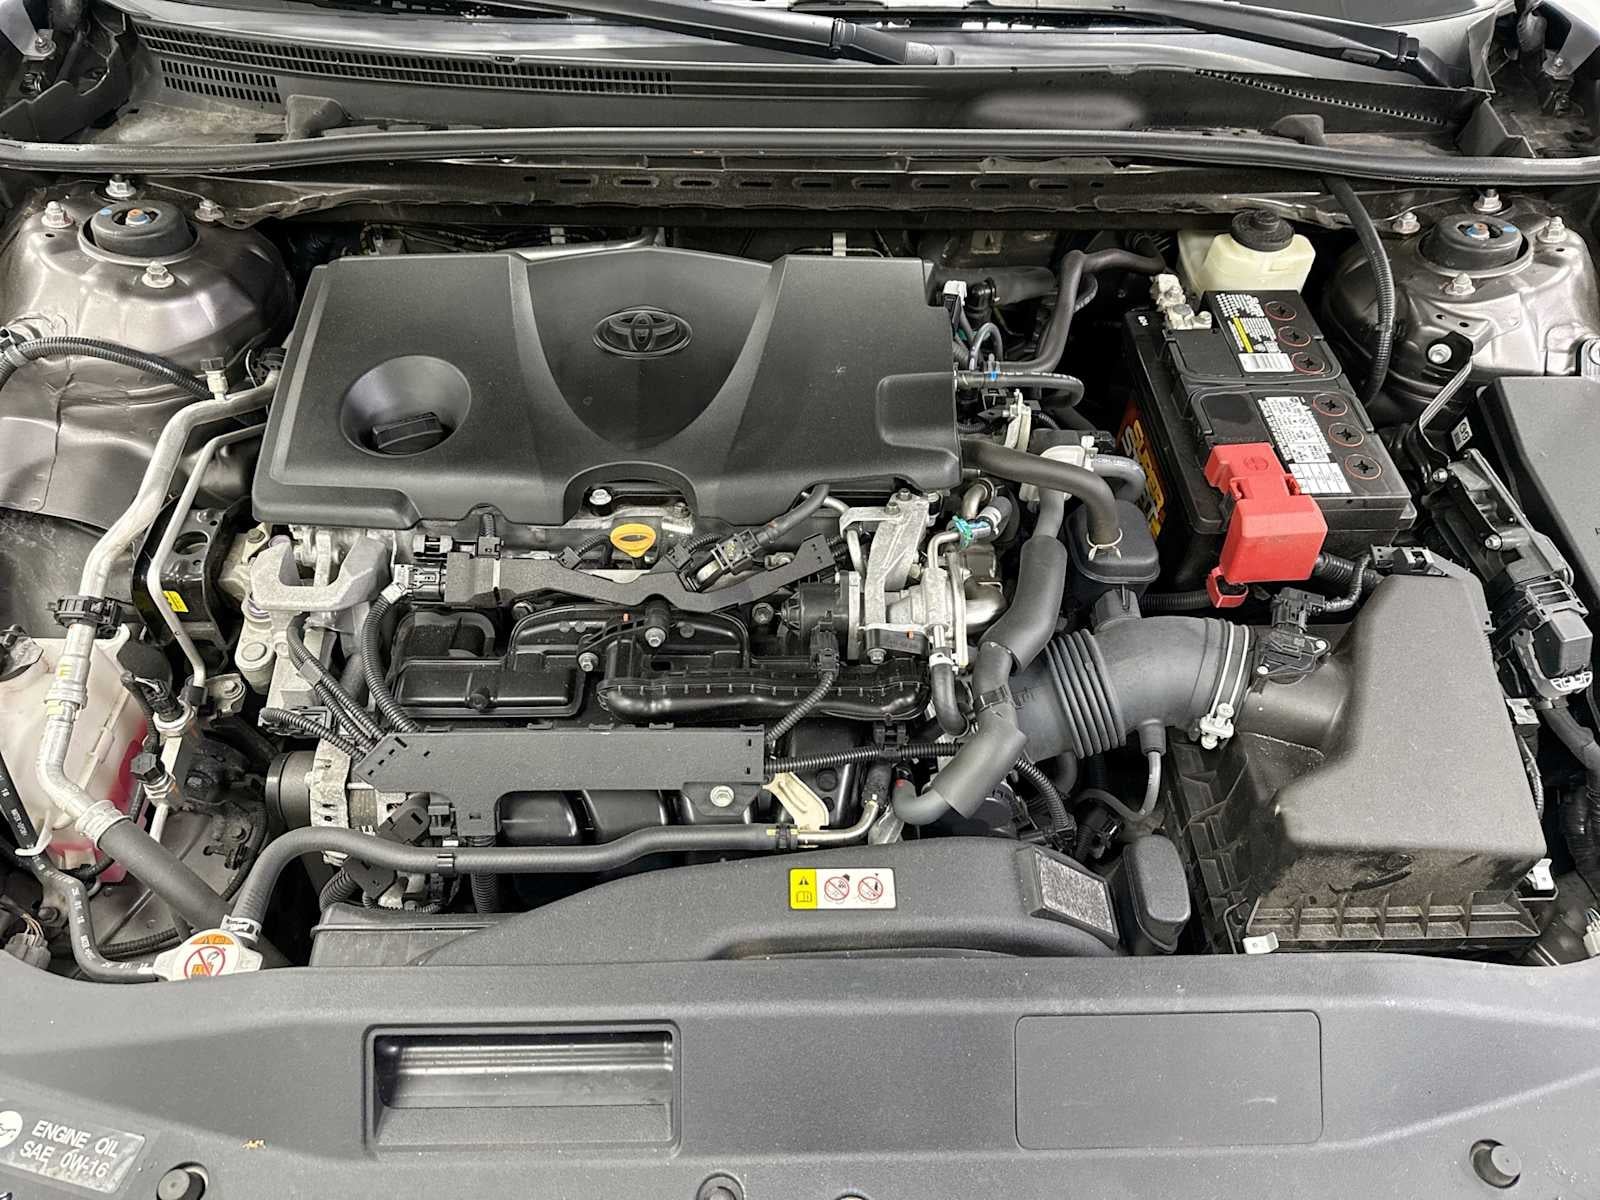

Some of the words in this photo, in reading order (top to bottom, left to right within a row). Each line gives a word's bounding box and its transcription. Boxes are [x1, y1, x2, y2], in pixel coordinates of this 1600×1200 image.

[31, 1119, 92, 1149] ENGINE
[94, 1136, 122, 1159] OIL
[19, 1140, 56, 1163] SAE
[59, 1151, 111, 1178] 0W-16
